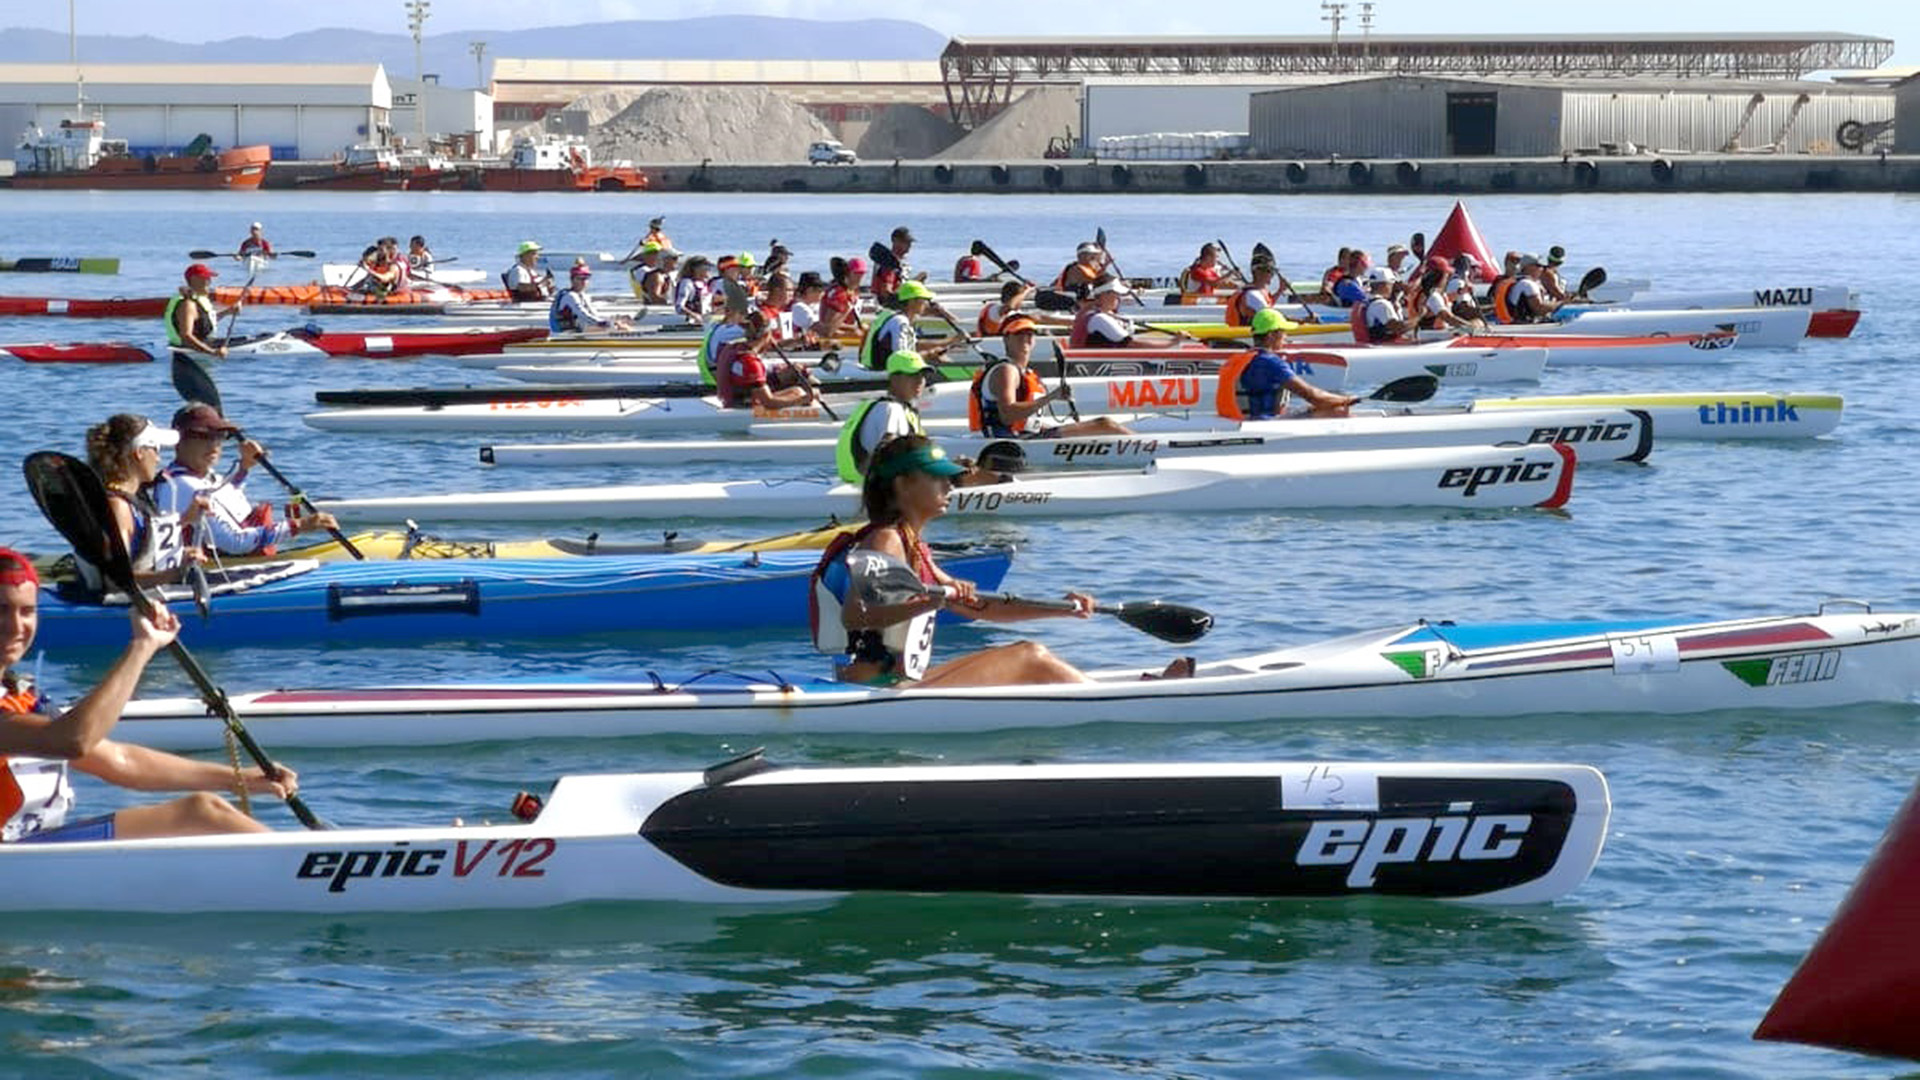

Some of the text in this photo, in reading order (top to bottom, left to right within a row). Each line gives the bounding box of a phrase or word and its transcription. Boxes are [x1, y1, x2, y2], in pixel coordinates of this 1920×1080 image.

[1754, 287, 1813, 307] MAZU
[1108, 377, 1200, 409] MAZU
[1698, 400, 1800, 426] think
[1528, 419, 1633, 443] epic
[1053, 440, 1113, 461] epic
[1116, 438, 1158, 456] V14
[1438, 458, 1555, 497] epic
[955, 492, 1052, 511] V10 SPORT
[1766, 650, 1841, 686] FENN
[1295, 801, 1532, 888] epic
[296, 837, 556, 892] epic V12
